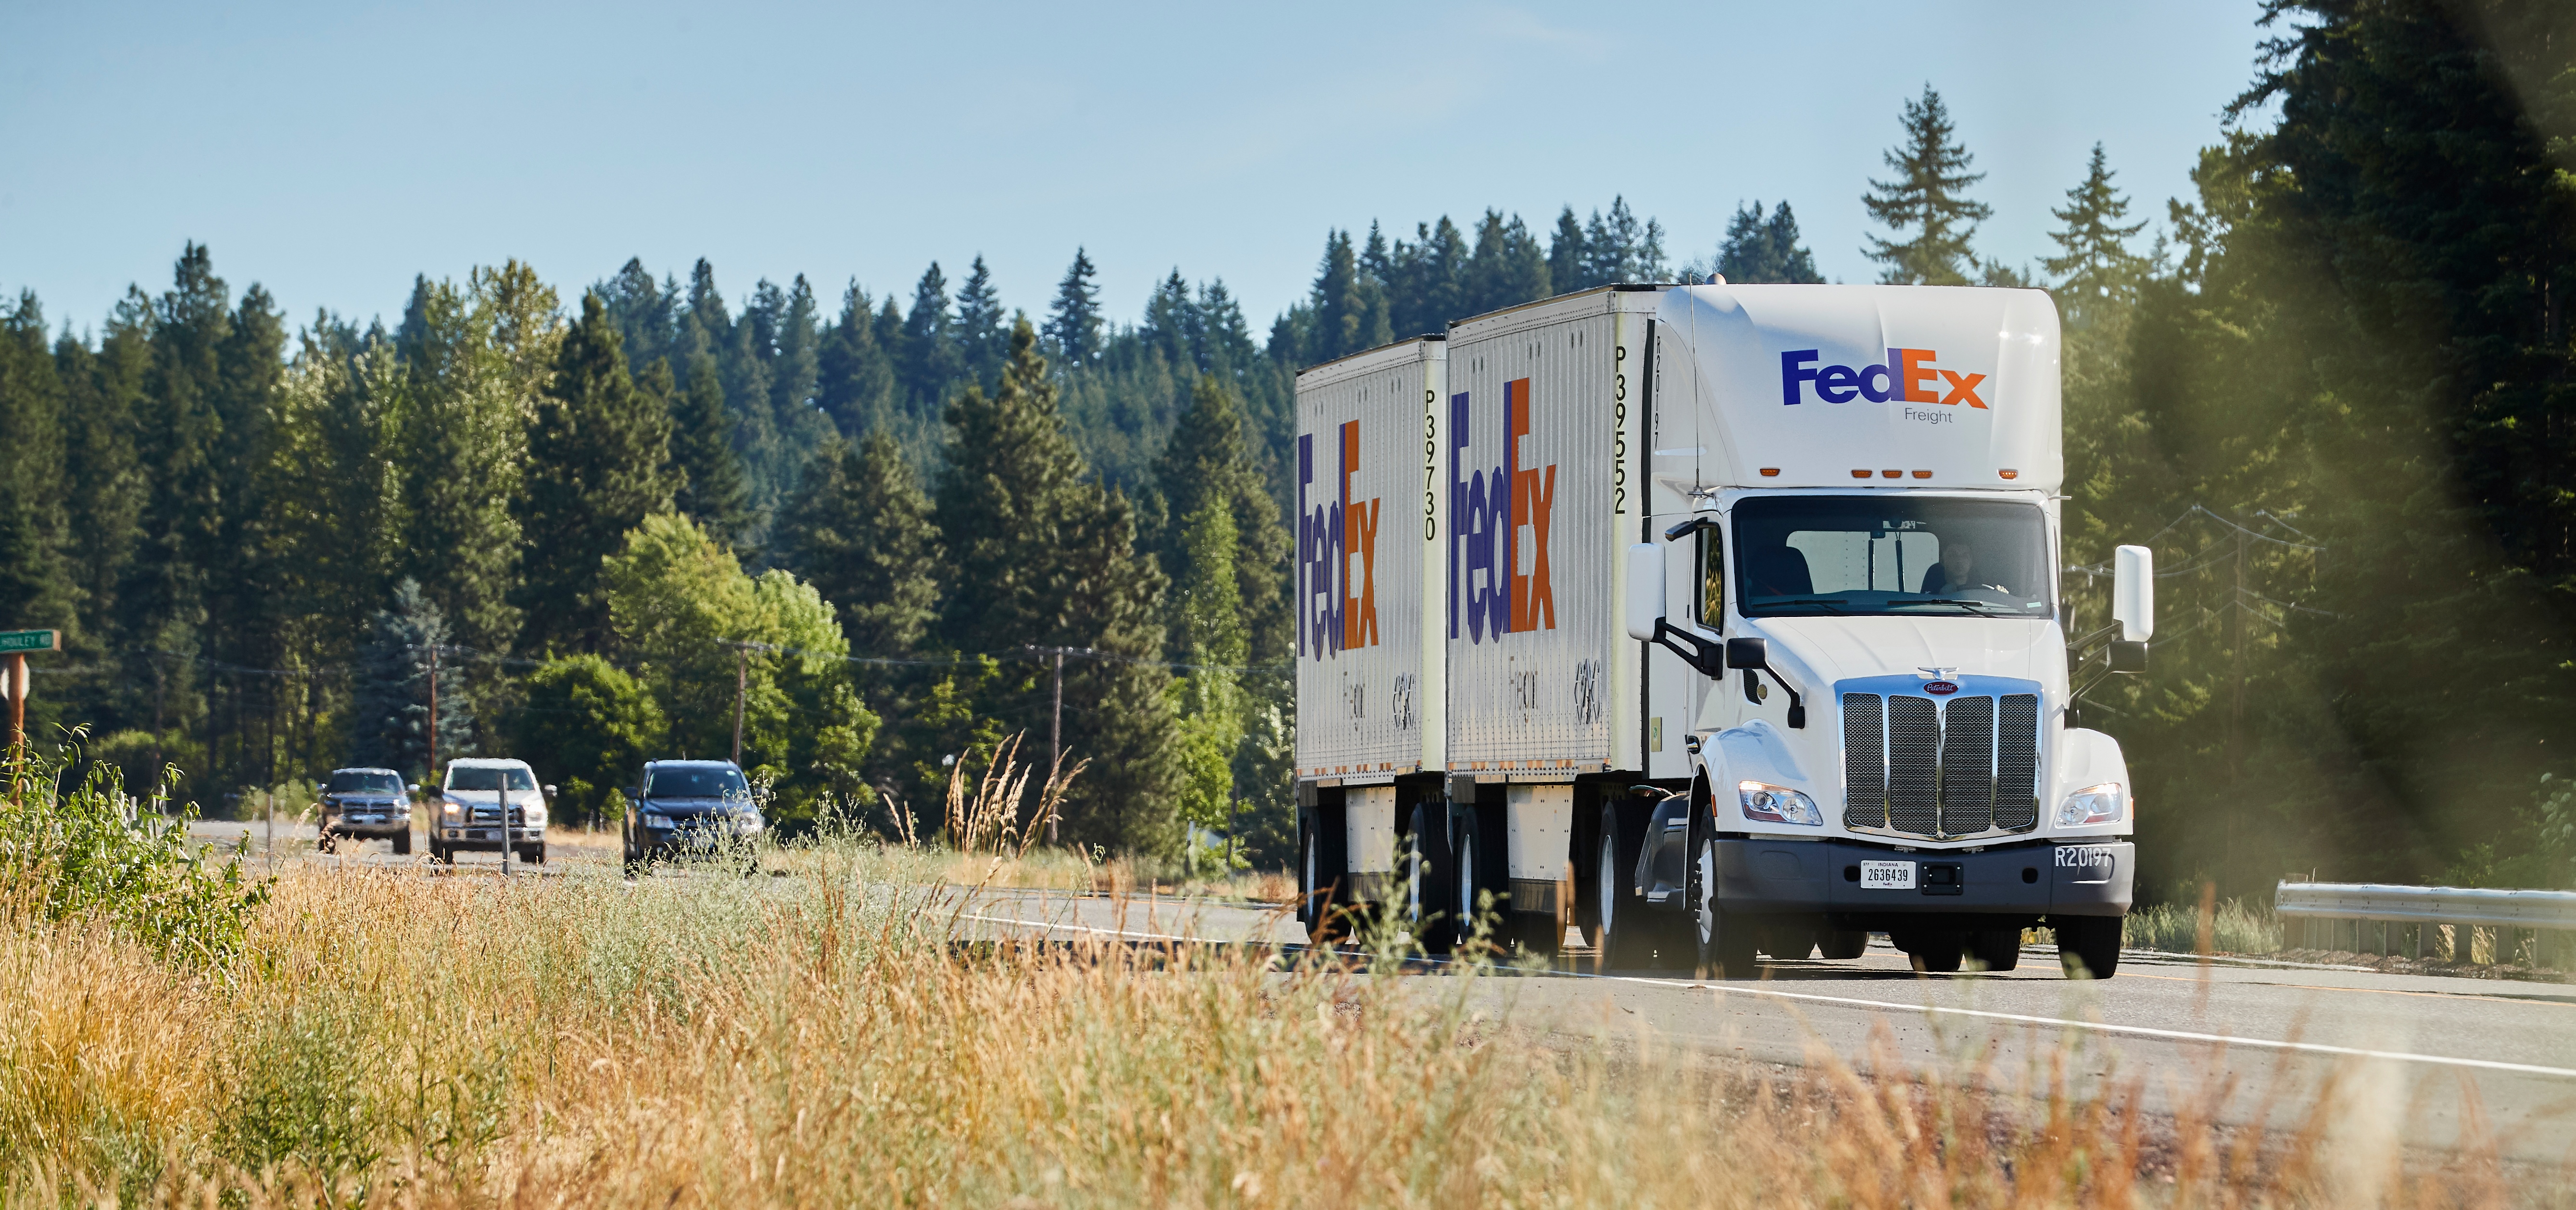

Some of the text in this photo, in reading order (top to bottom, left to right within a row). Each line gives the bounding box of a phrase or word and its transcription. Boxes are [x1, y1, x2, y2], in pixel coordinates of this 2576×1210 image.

[1781, 348, 1989, 409] FedEx
[1615, 346, 1626, 514] P39552
[1905, 407, 1953, 424] Freight
[1426, 390, 1435, 541] P39730
[1299, 419, 1380, 661] FedEx
[1451, 377, 1556, 645] FedEx
[1344, 669, 1365, 731] Feght
[1868, 869, 1908, 881] 2636439
[2055, 847, 2111, 867] R20197
